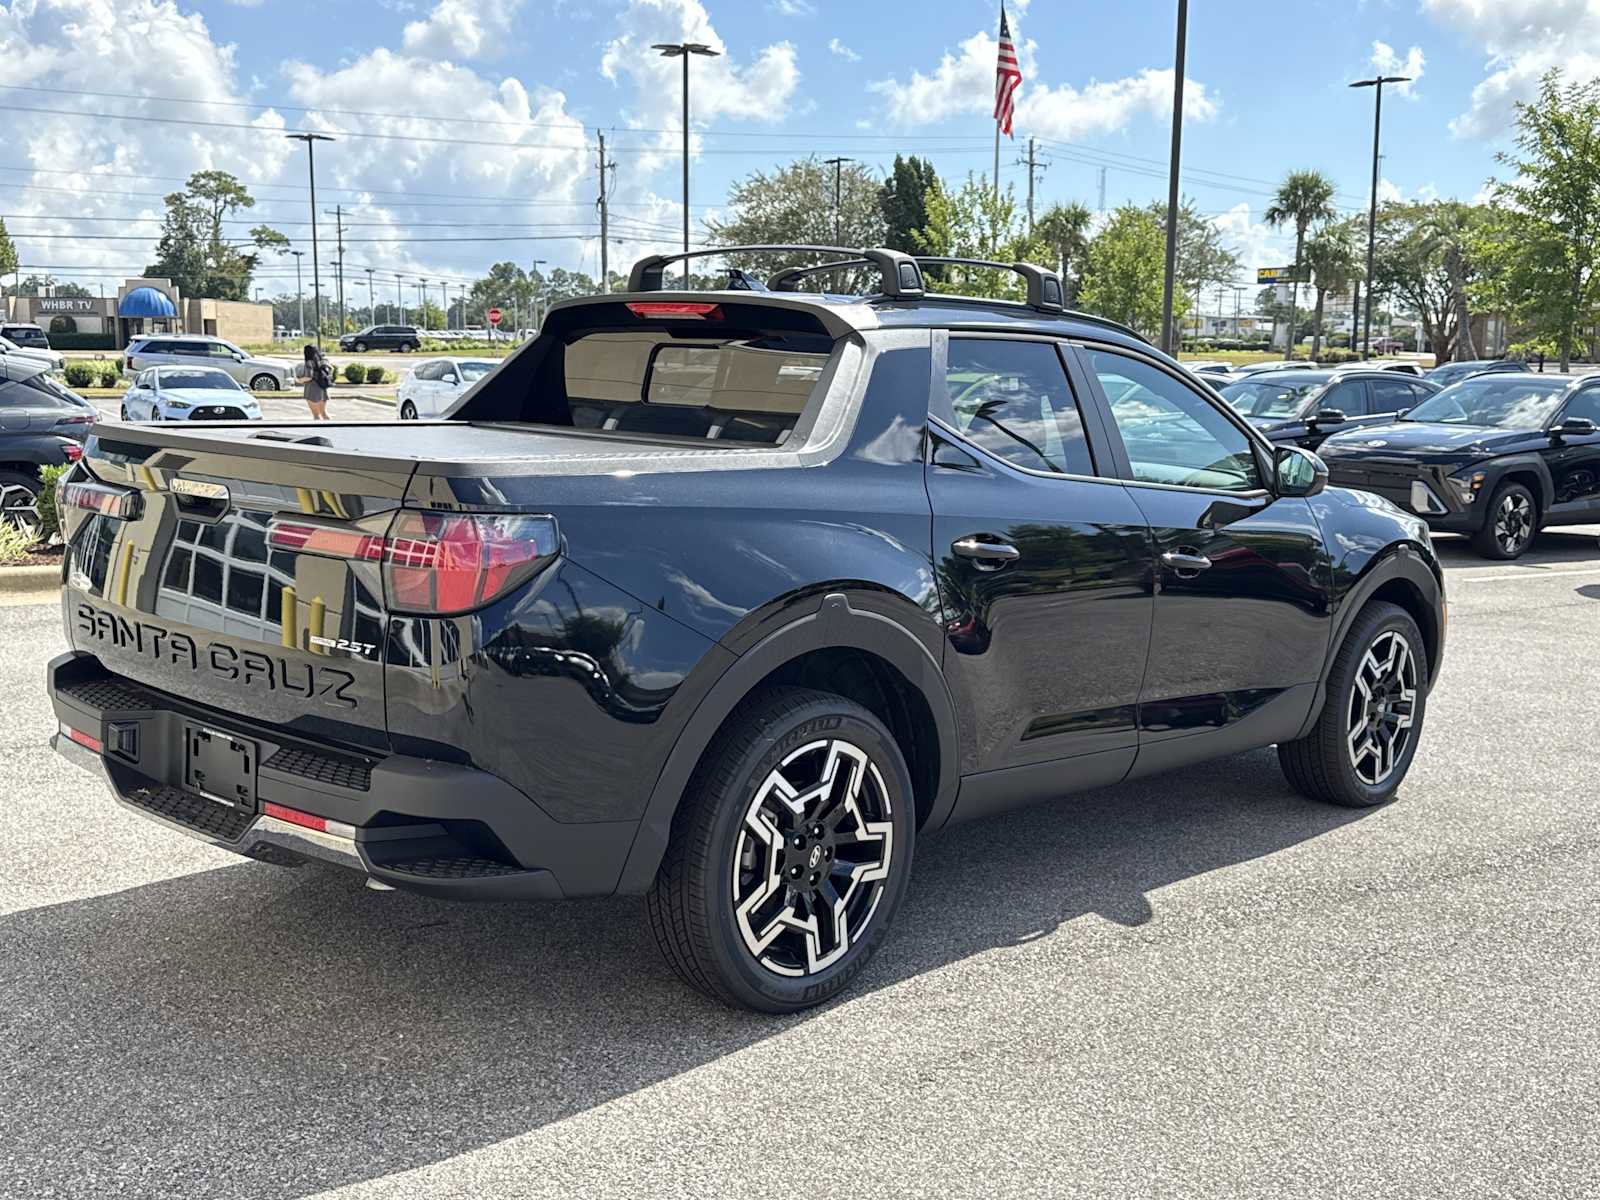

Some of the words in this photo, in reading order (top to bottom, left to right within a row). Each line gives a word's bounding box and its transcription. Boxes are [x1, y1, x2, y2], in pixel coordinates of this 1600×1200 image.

[41, 300, 73, 310] WHBR
[78, 300, 92, 310] TV
[78, 603, 198, 670] SANTA
[208, 642, 358, 708] CRUZ
